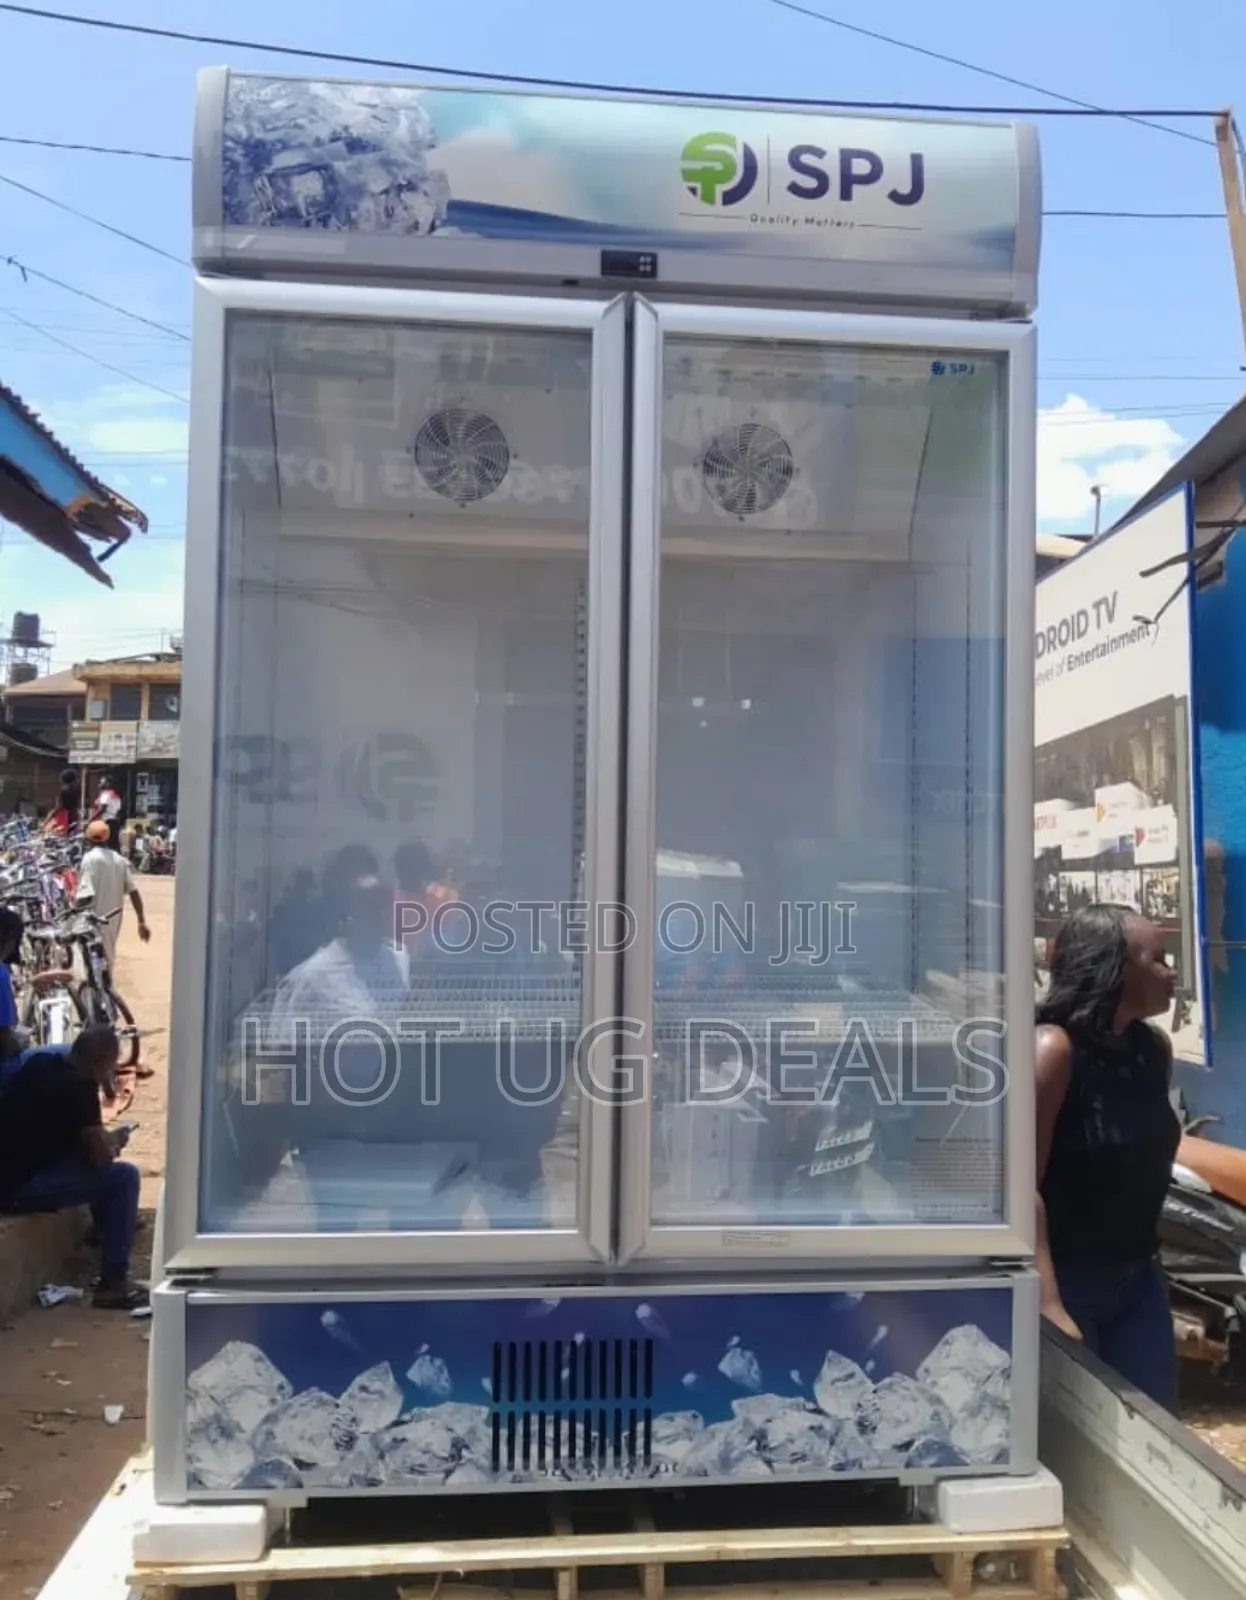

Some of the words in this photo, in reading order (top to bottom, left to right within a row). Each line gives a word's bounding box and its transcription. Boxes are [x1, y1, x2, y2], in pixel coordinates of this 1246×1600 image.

[787, 144, 925, 206] SPJ
[750, 212, 799, 228] Quality
[804, 216, 854, 231] Matters
[948, 362, 975, 376] SPJ
[1035, 609, 1088, 659] DROID
[1092, 589, 1118, 630] TV
[1067, 622, 1150, 672] Entertainment
